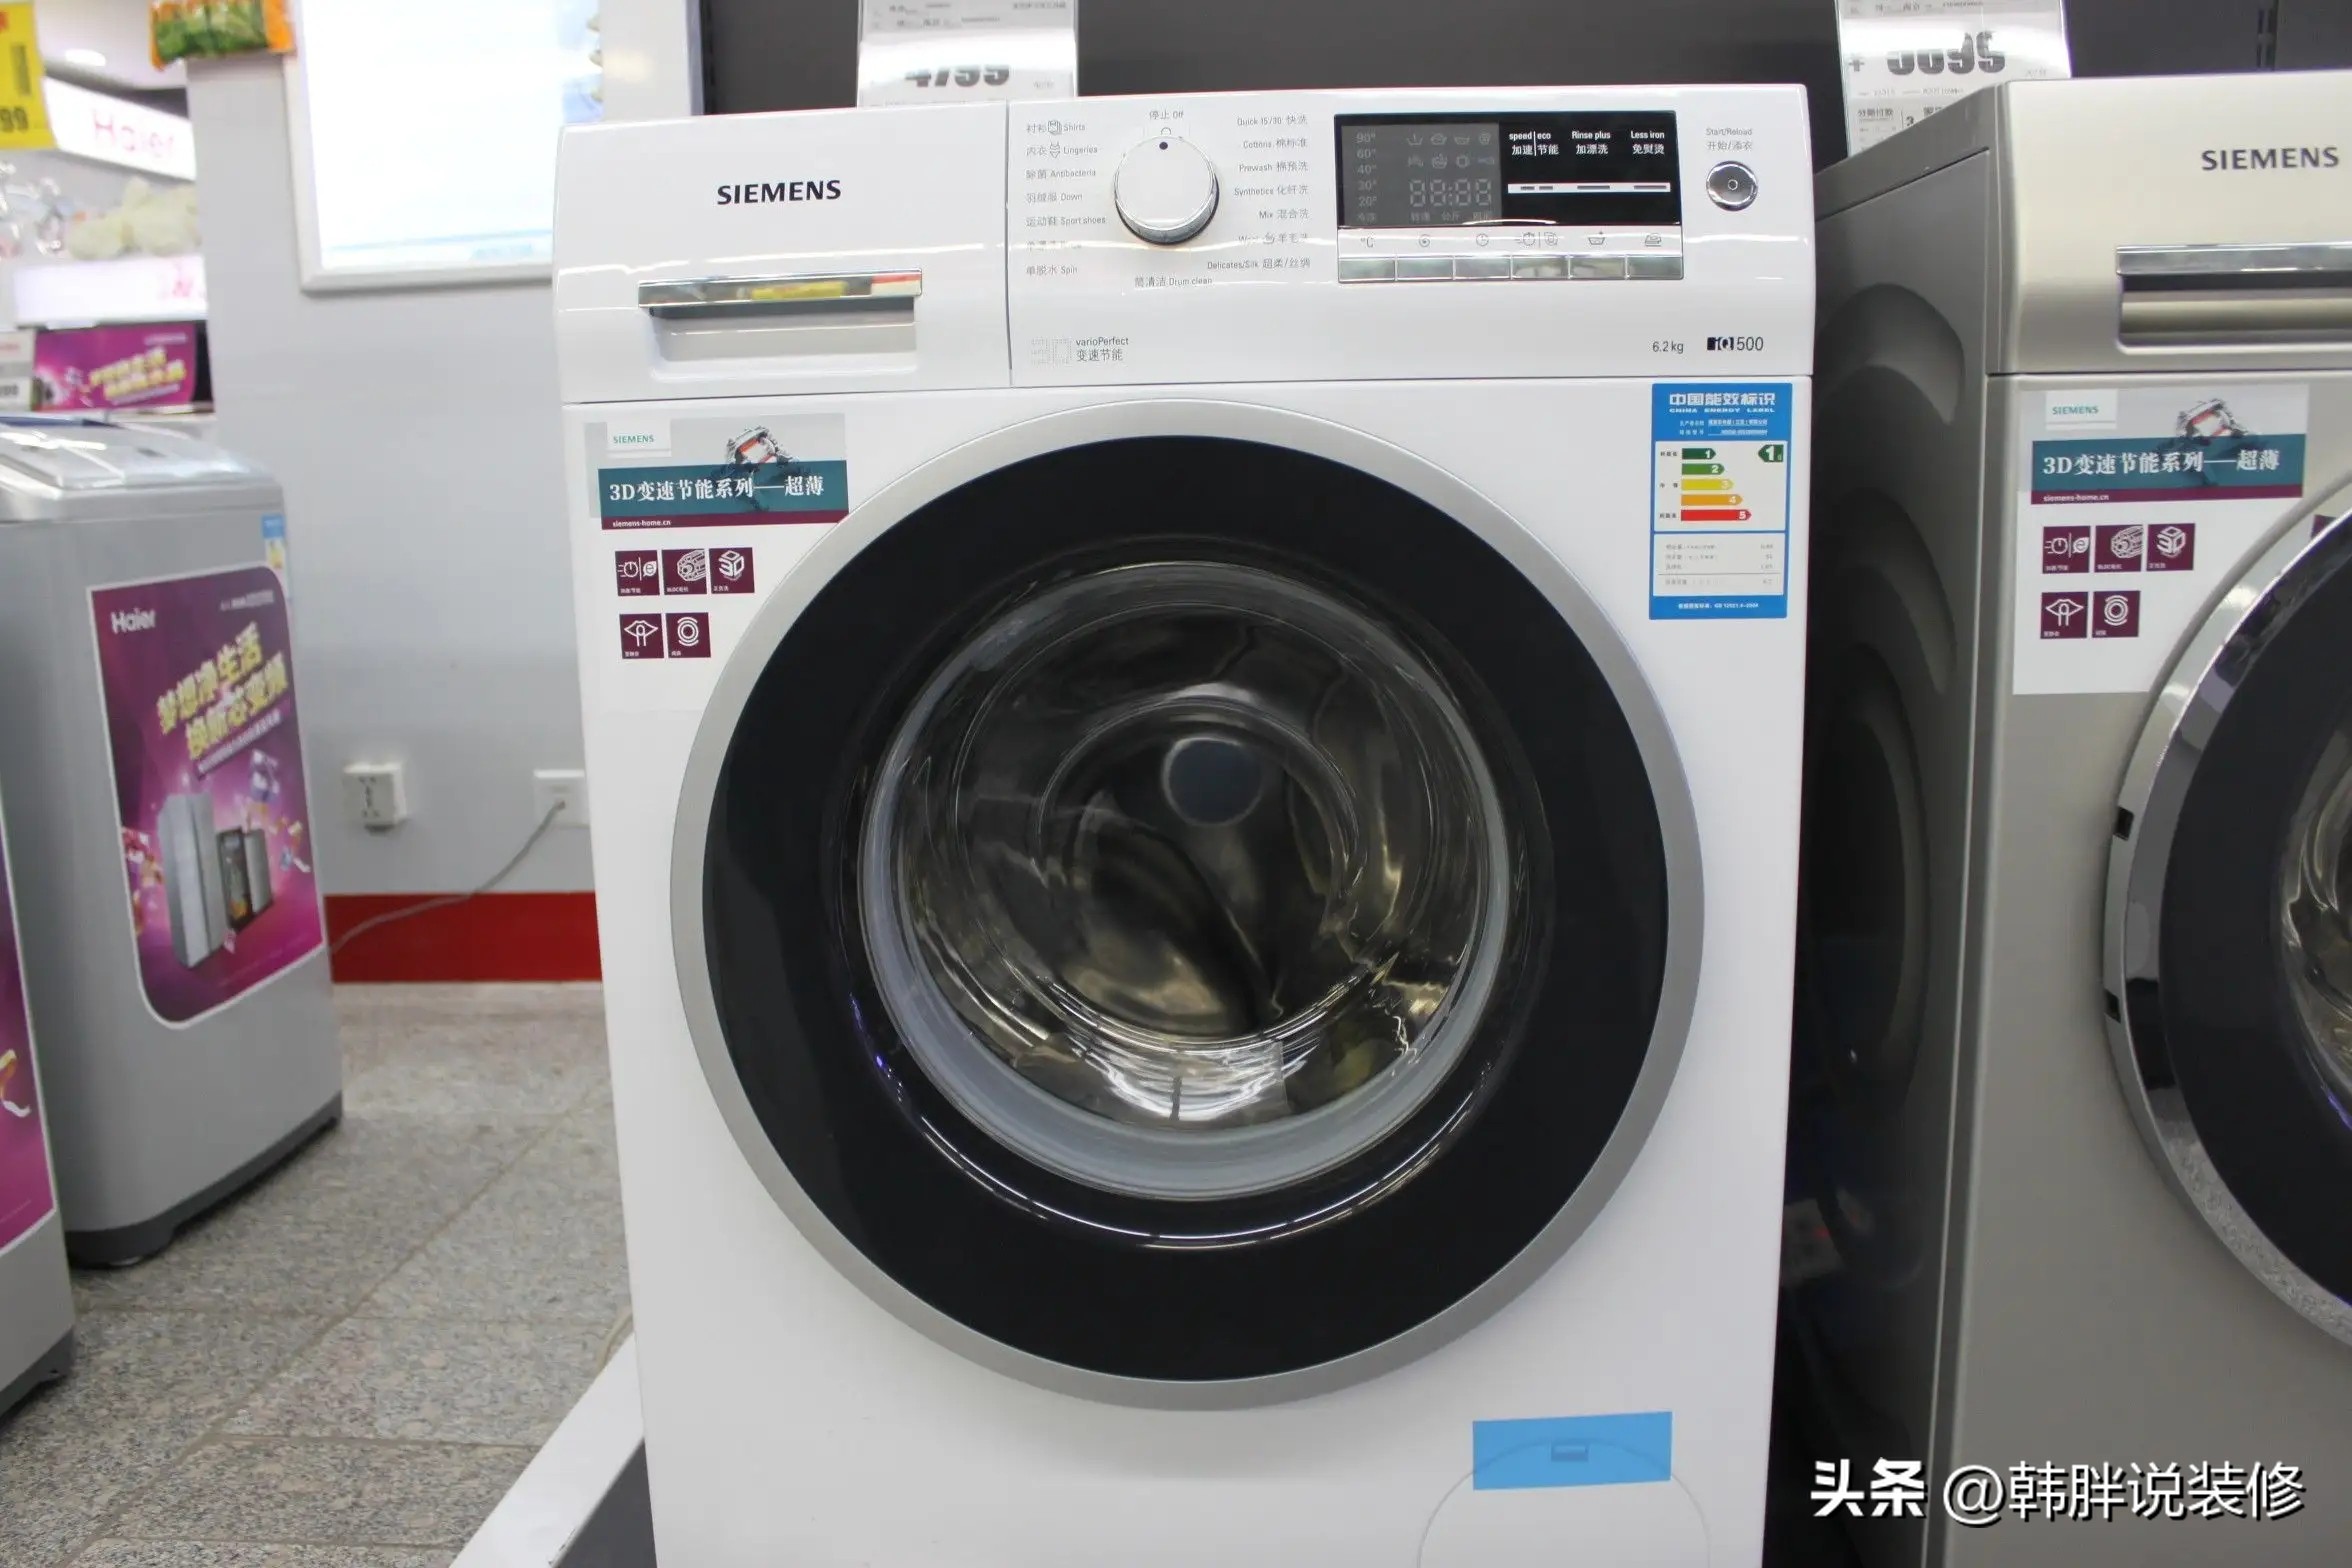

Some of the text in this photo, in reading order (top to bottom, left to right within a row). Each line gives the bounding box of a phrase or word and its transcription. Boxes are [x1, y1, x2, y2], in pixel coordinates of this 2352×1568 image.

[1063, 123, 1086, 132] Shirts
[1509, 131, 1551, 140] speed eco
[1571, 130, 1611, 140] Rinse plus
[1630, 130, 1665, 139] Less iron
[1063, 146, 1098, 155] Lingeries
[1511, 144, 1559, 156] 加速 节能
[1575, 144, 1609, 155] 加漂洗
[1632, 144, 1665, 155] 免熨烫
[2201, 147, 2339, 171] SIEMENS
[717, 180, 841, 205] SIEMENS
[1060, 192, 1083, 201] Down
[1075, 337, 1129, 346] varioPerfect
[1077, 348, 1124, 362] 变速节能
[1669, 393, 1776, 406] 中国能效标识
[2052, 404, 2099, 415] SIEMENS
[613, 434, 654, 444] SIEMENS
[1766, 446, 1775, 461] 1
[1711, 465, 1719, 474] 2
[1739, 511, 1747, 520] 5
[612, 519, 671, 528] siemens-home.cn
[111, 606, 155, 634] Haier
